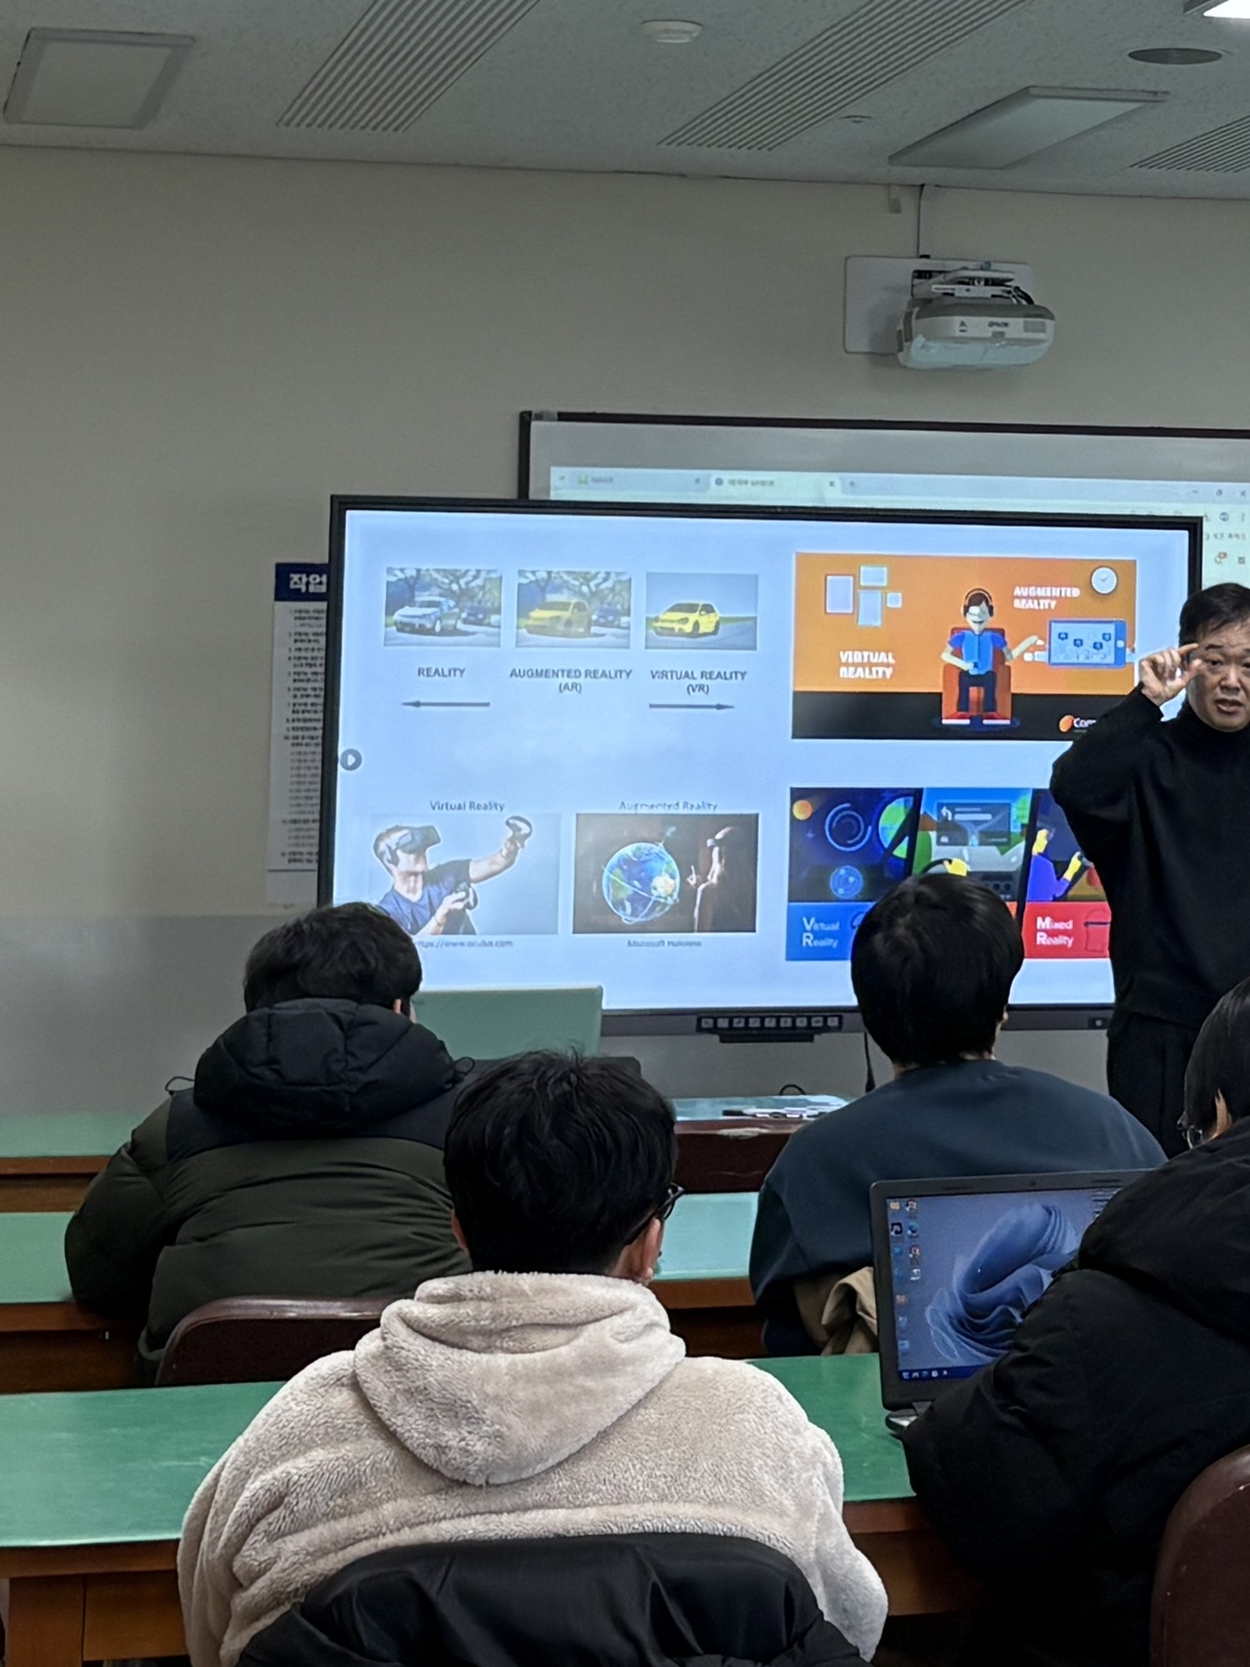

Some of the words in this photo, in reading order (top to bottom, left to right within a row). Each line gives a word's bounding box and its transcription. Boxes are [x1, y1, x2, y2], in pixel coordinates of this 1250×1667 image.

[1013, 586, 1081, 598] AUGMENTED
[1013, 598, 1057, 610] REALITY
[839, 651, 896, 664] VIRTUAL
[417, 667, 466, 678] REALITY
[509, 668, 581, 680] AUGMENTED
[584, 669, 633, 680] REALITY
[650, 670, 697, 681] VIRTUAL
[700, 670, 747, 681] REALITY
[839, 666, 893, 679] REALITY
[558, 681, 582, 693] (AR)
[686, 683, 709, 695] (VR)
[429, 801, 466, 811] Virtual
[469, 801, 505, 812] Reality
[682, 801, 719, 812] Reality
[802, 916, 840, 931] Virtual
[1036, 916, 1073, 931] Mixed
[802, 932, 838, 948] Reality
[1036, 932, 1075, 948] Reality
